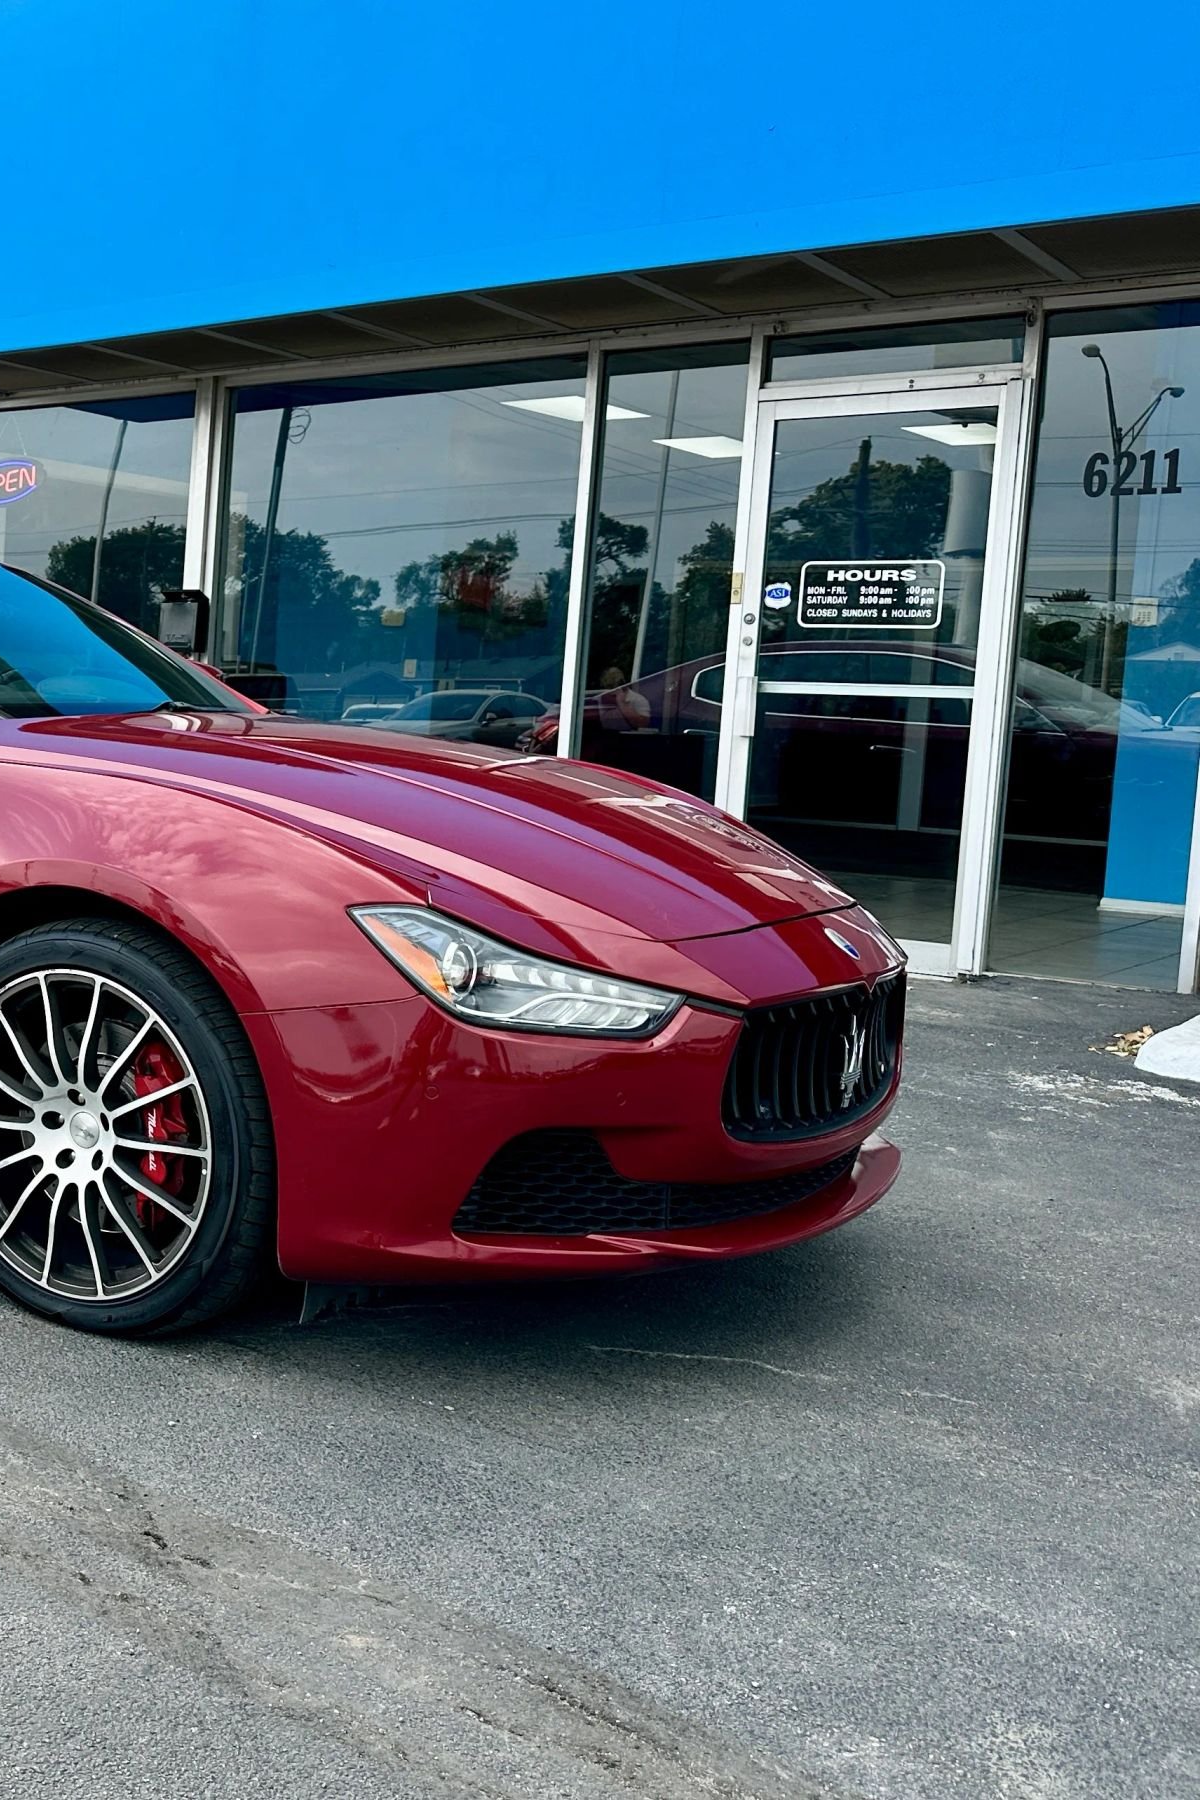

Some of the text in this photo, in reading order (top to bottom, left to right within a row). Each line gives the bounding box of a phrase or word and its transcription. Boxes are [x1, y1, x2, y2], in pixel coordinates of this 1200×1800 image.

[1083, 448, 1182, 498] 6211
[826, 569, 917, 582] HOURS
[806, 595, 848, 605] SATURDAY
[806, 608, 932, 618] CLOSED SUNDAYS & HOLIDAYS
